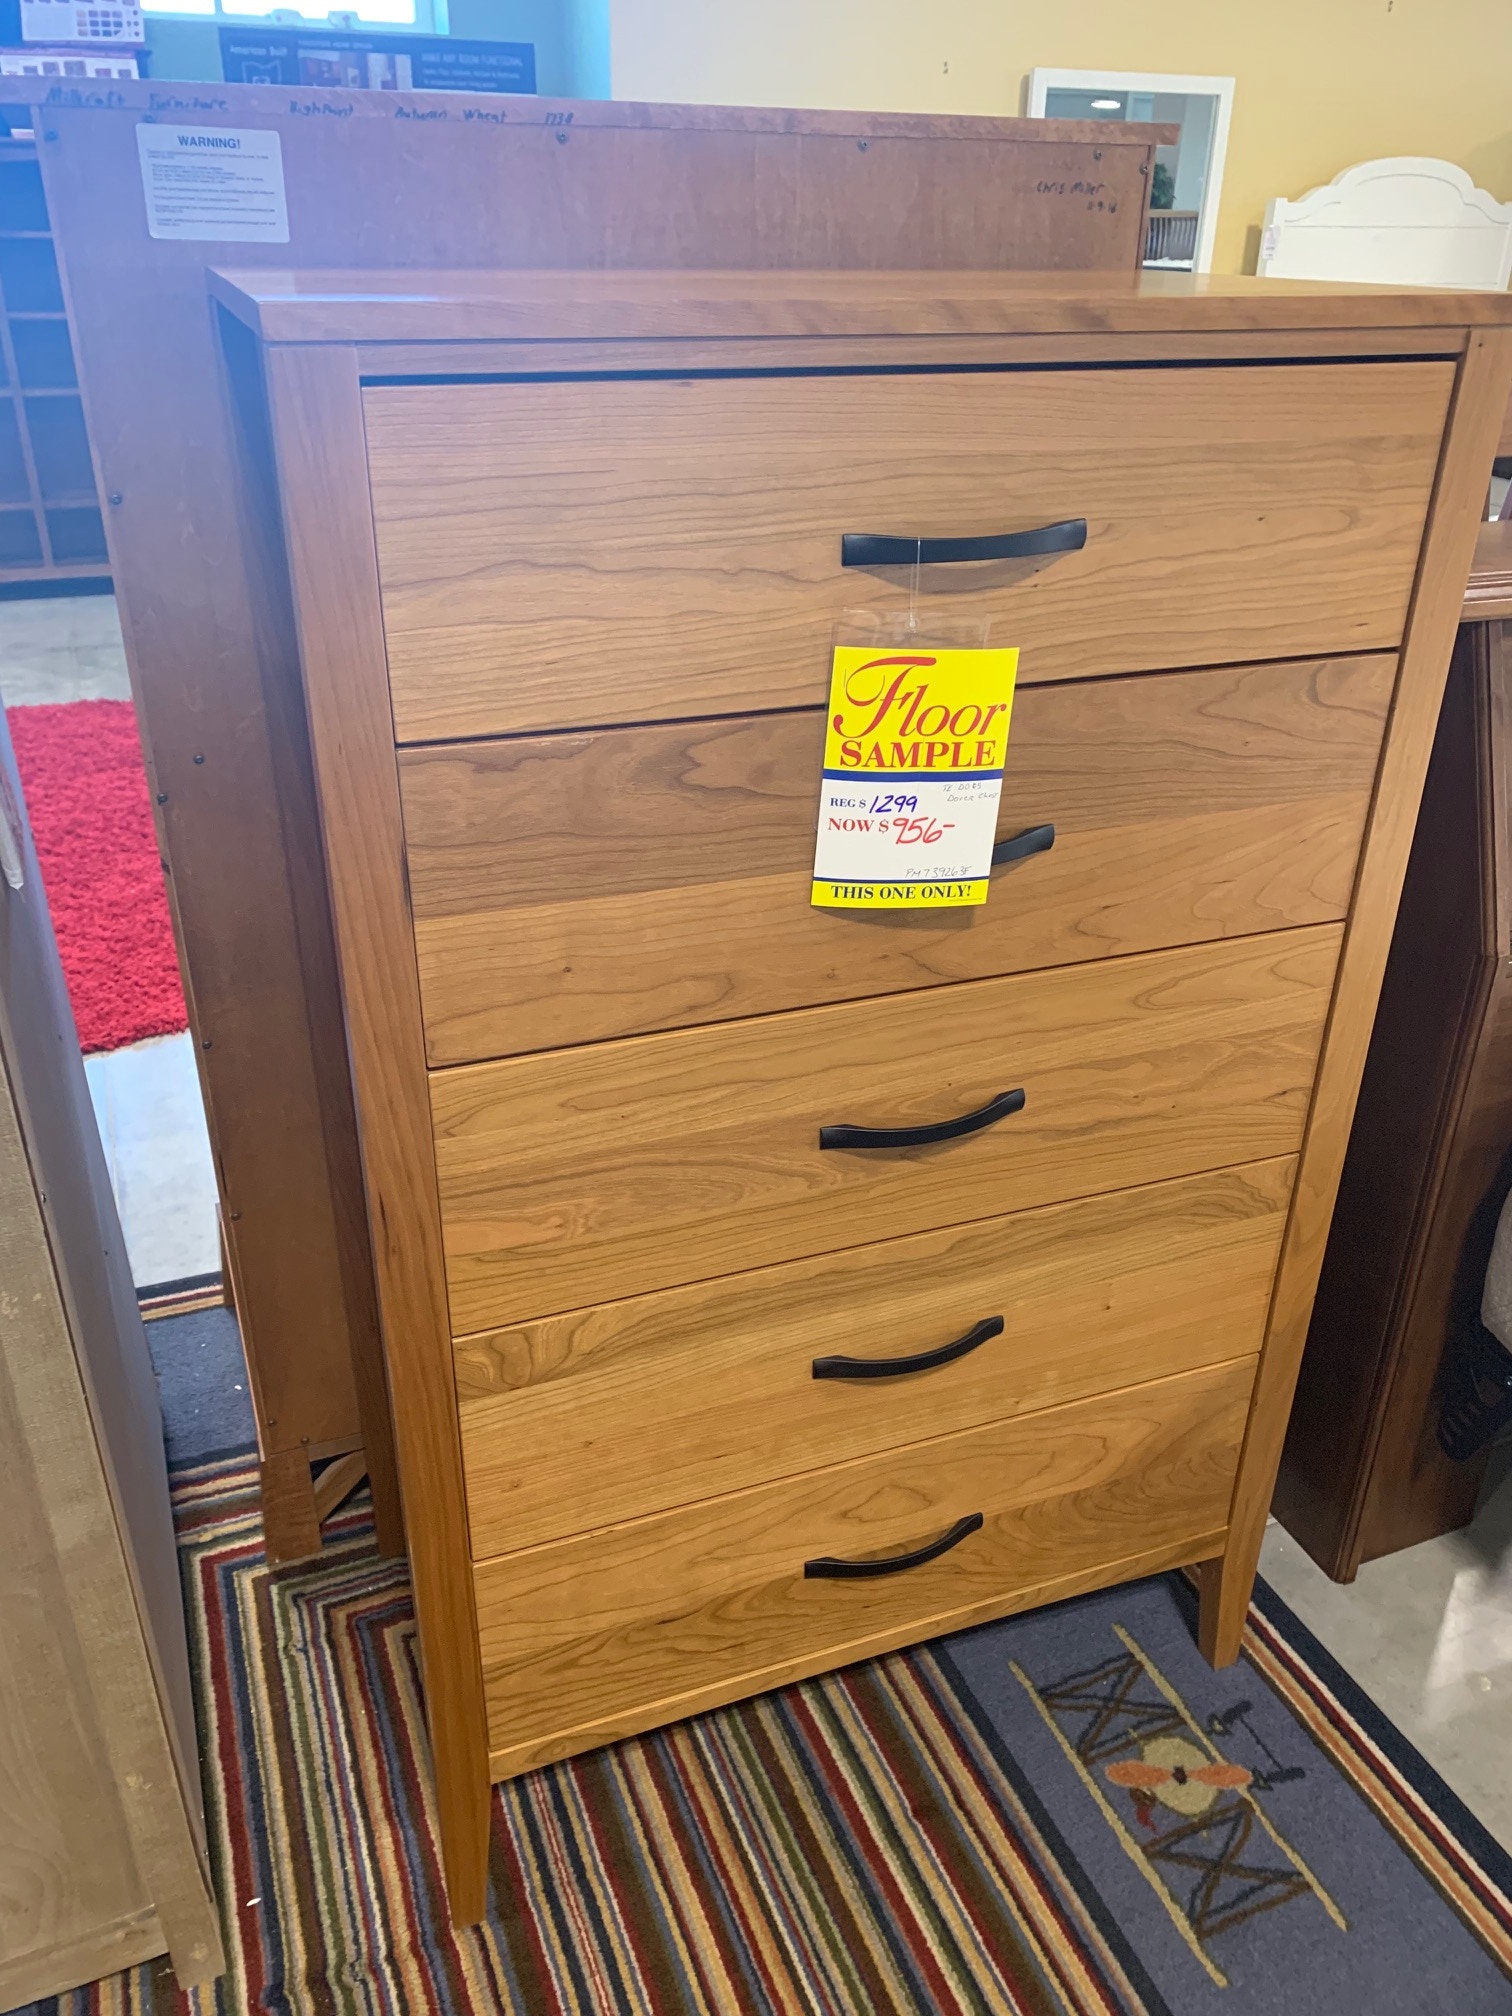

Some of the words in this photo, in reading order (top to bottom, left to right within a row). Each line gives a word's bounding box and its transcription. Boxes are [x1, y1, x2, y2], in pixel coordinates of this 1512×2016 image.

[463, 108, 507, 124] Wheat
[177, 135, 241, 149] WARNING!
[833, 656, 1007, 739] Floor
[840, 739, 996, 768] SAMPLE
[830, 797, 855, 808] REG
[828, 817, 874, 833] NOW
[831, 885, 874, 899] THIS
[880, 885, 916, 900] ONE
[921, 884, 972, 899] ONLY!
